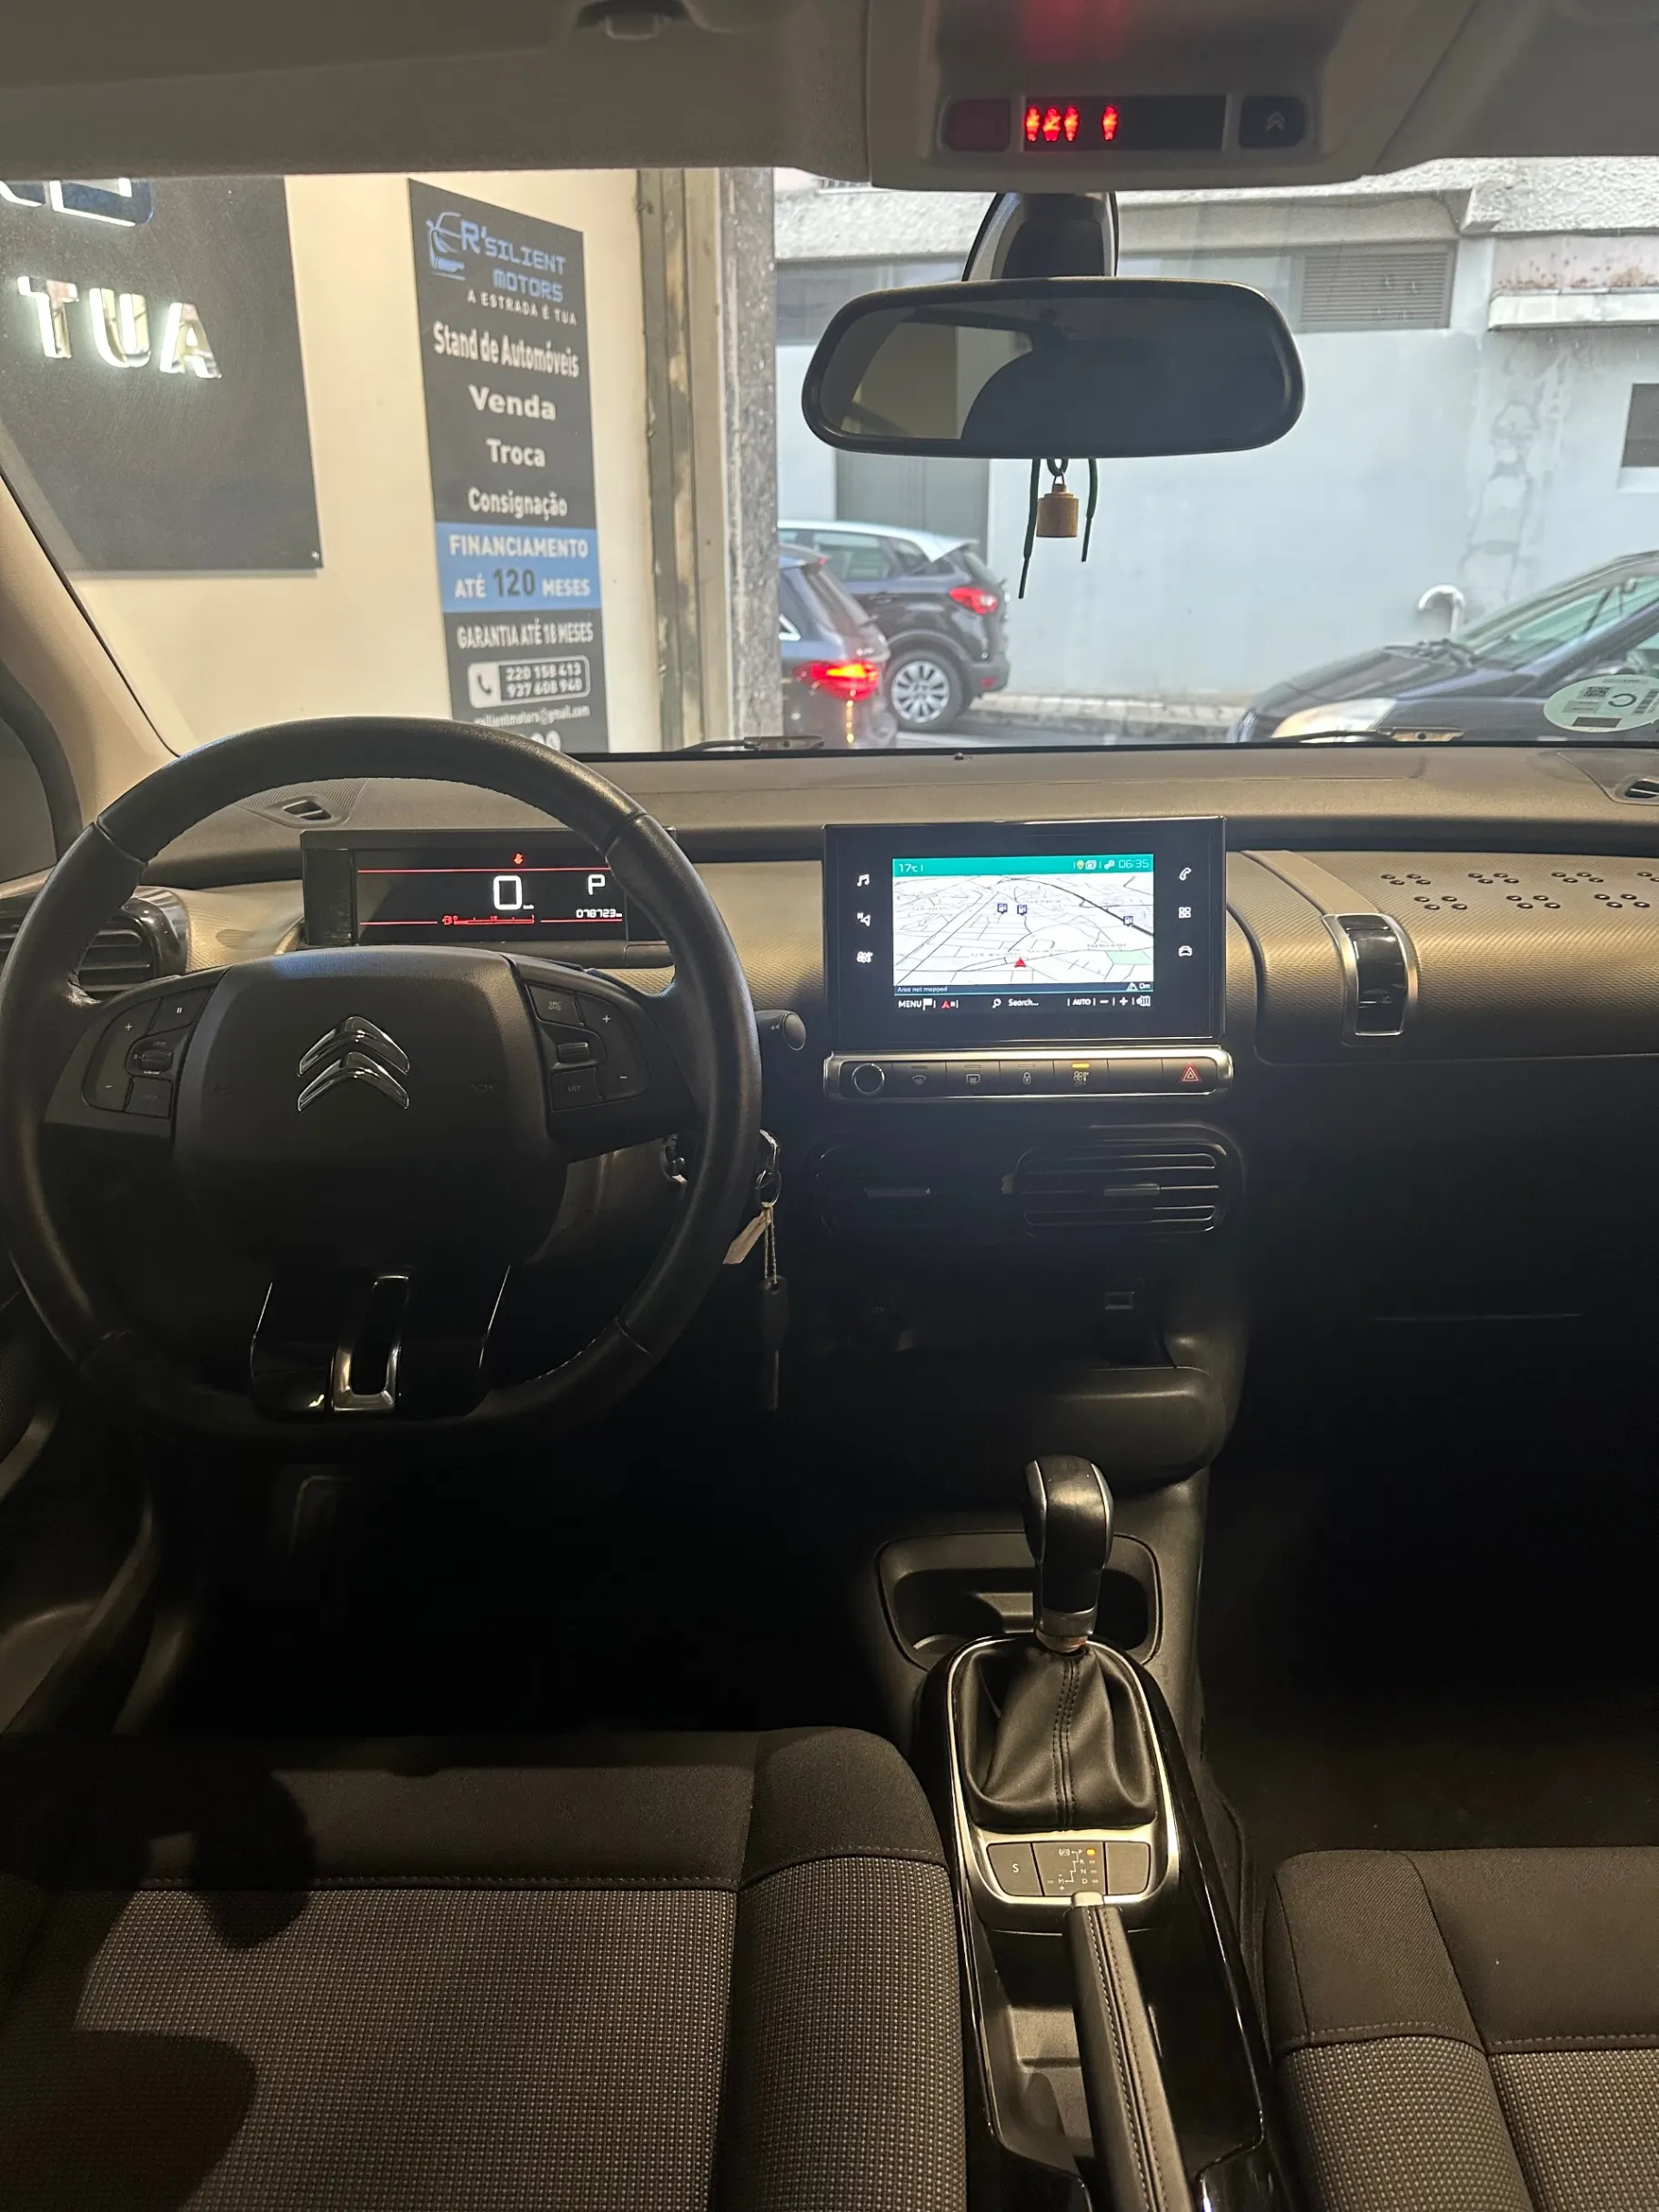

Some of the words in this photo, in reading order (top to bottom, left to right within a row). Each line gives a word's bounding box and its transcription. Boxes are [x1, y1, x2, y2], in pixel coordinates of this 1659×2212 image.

[460, 220, 567, 276] R'SILIENT
[492, 268, 564, 303] MOTORS
[467, 288, 477, 304] A
[480, 292, 538, 317] ESTRADA
[554, 308, 578, 327] TUA
[17, 276, 222, 379] TUA
[433, 321, 478, 360] Stand
[480, 331, 500, 364] de
[500, 336, 580, 378] Automóveis
[468, 384, 558, 422] Venda
[485, 437, 547, 468] Troca
[468, 487, 568, 521] Consignação
[448, 534, 589, 558] FINANCIAMENTO
[455, 573, 488, 598] ATÉ
[493, 567, 537, 598] 120
[541, 578, 591, 598] MESES
[457, 625, 519, 649] GARANTIA
[519, 616, 543, 647] ATÉ
[558, 620, 594, 645] MESES
[1118, 859, 1150, 869] 06:35
[492, 875, 523, 910] 0
[588, 874, 606, 896] P
[575, 909, 617, 920] 078723
[898, 1000, 922, 1009] MENU
[923, 986, 948, 994] mapped
[1008, 998, 1040, 1008] Search...
[1072, 999, 1091, 1007] AUTO
[1011, 1863, 1020, 1874] S
